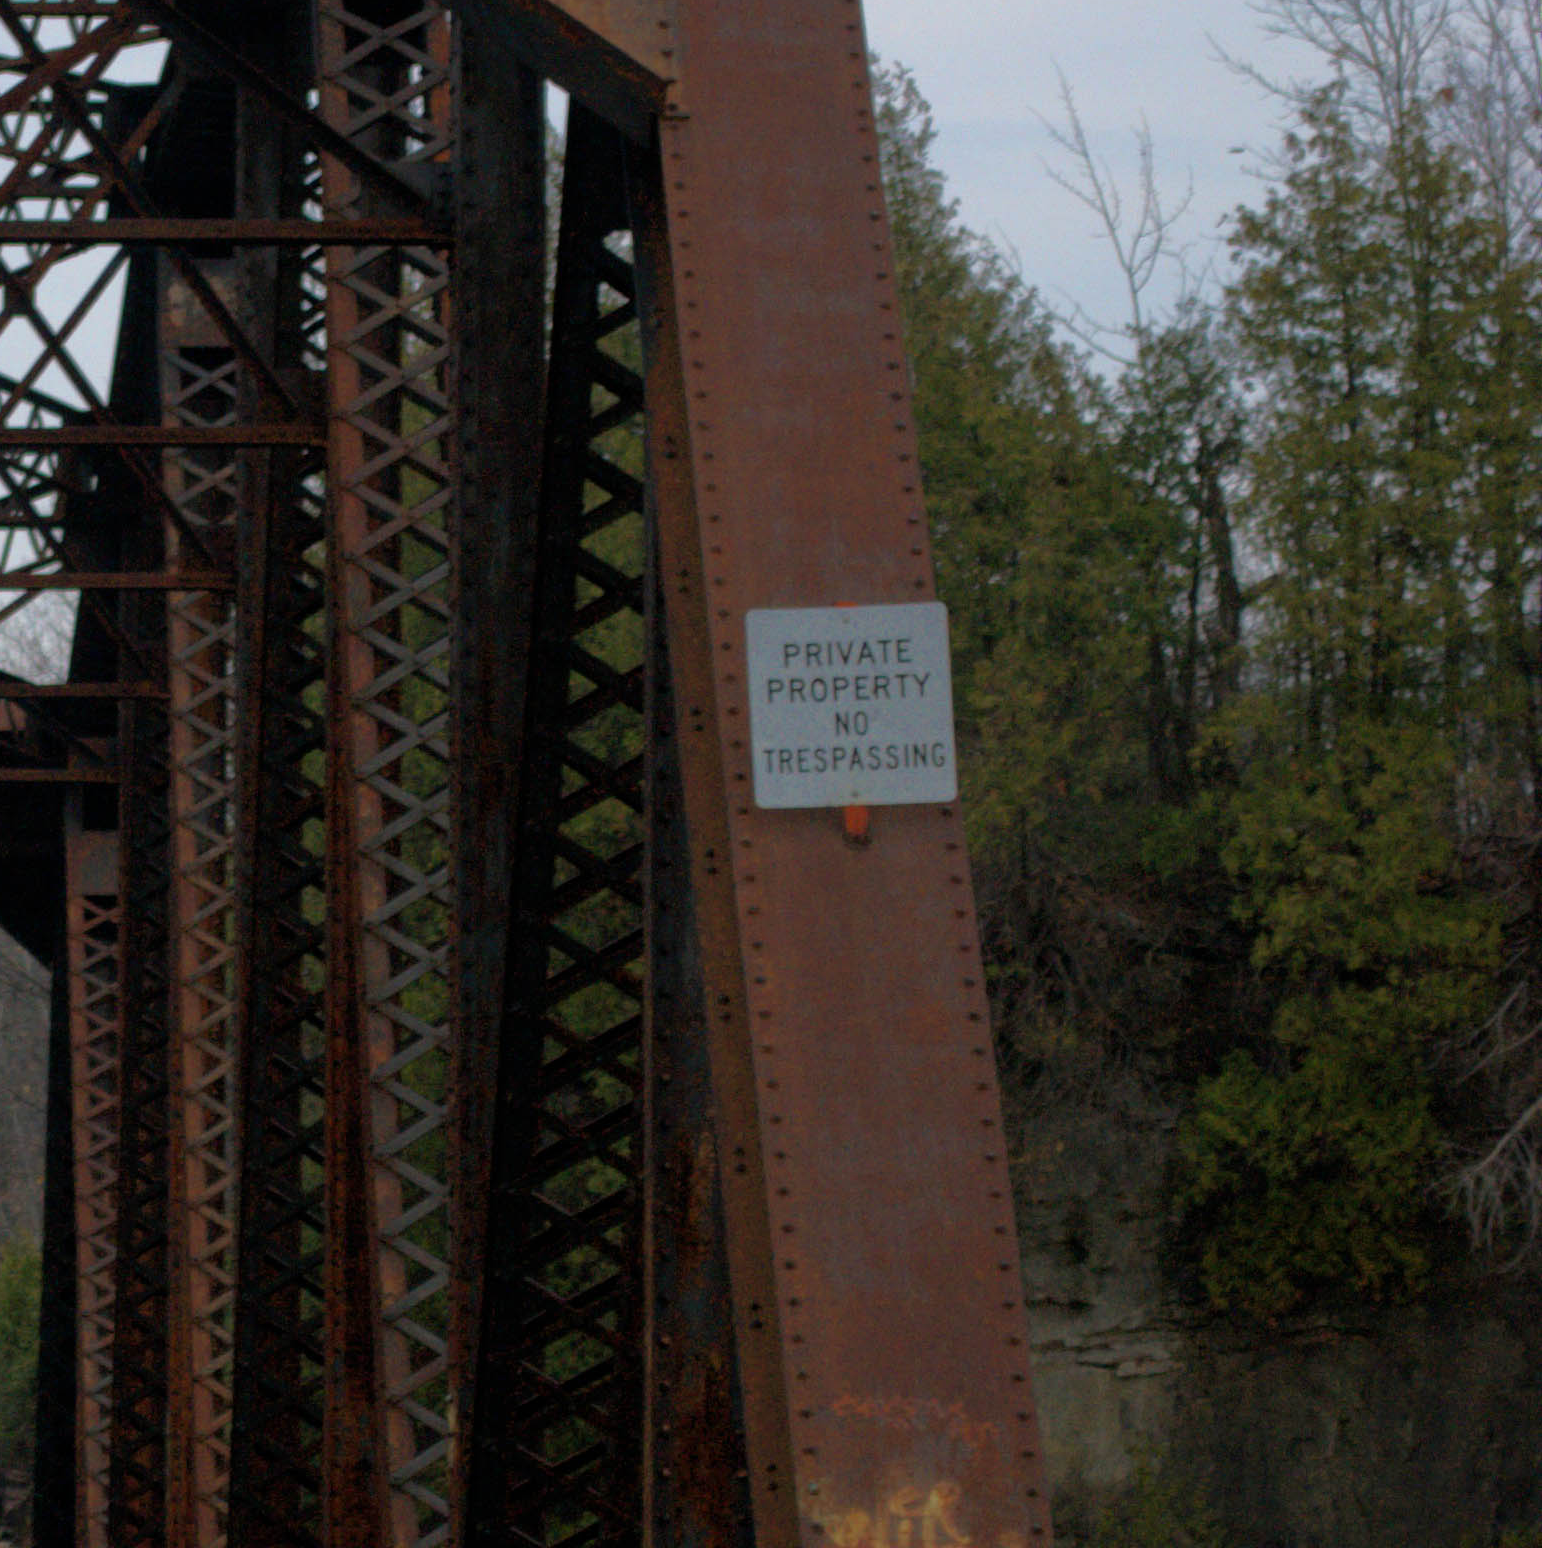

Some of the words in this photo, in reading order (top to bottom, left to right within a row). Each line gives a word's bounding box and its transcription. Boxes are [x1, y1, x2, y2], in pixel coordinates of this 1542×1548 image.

[783, 639, 913, 667] PRIVATE
[767, 672, 931, 703] PROPERTY
[834, 711, 869, 736] NO
[763, 742, 946, 774] TRESPASSING
